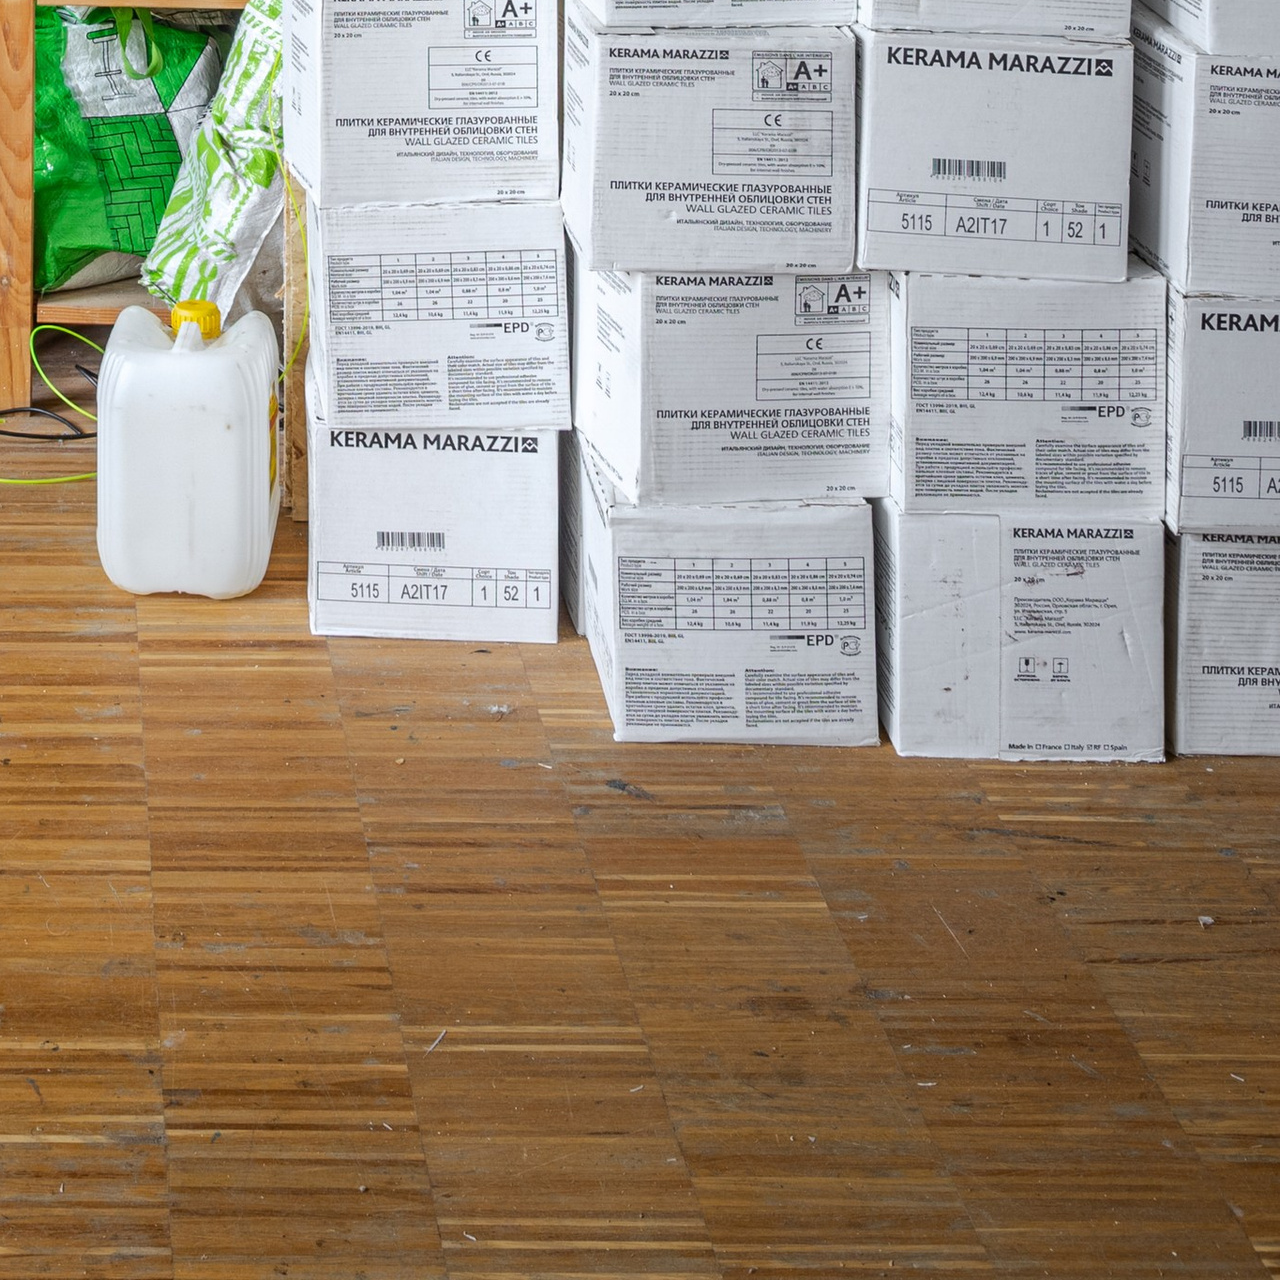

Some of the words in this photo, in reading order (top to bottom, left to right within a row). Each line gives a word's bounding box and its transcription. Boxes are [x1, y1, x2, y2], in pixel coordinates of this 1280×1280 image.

[502, 0, 533, 18] A+
[609, 48, 660, 59] KERAMA
[663, 49, 718, 60] MARAZZI
[887, 46, 982, 70] KERAMA
[988, 53, 1092, 75] MARAZZI
[794, 61, 828, 80] A+
[1210, 65, 1263, 78] KERAMA
[336, 118, 374, 126] ПЛИТКИ
[377, 117, 453, 126] КЕРАМИЧЕСКИЕ
[456, 116, 537, 125] ГЛАЗУРОВАННЫЕ
[368, 128, 386, 137] ДЛЯ
[389, 126, 450, 136] ВНУТРЕННЕЙ
[453, 126, 512, 137] ОБЛИЦОВКИ
[515, 126, 538, 134] СТЕН
[405, 137, 431, 146] WALL
[434, 137, 470, 146] GLAZED
[472, 136, 514, 145] CERAMIC
[516, 136, 538, 144] TILES
[610, 180, 653, 190] ПЛИТКИ
[655, 181, 739, 192] КЕРАМИЧЕСКИЕ
[742, 183, 832, 194] ГЛАЗУРОВАННЫЕ
[645, 192, 666, 203] ДЛЯ
[669, 192, 735, 203] ВНУТРЕННЕЙ
[738, 194, 804, 205] ОБЛИЦОВКИ
[807, 195, 832, 204] СТЕН
[686, 204, 715, 214] WALL
[717, 204, 757, 214] GLAZED
[760, 205, 806, 215] CERAMIC
[808, 206, 832, 215] TILES
[1205, 200, 1248, 210] ПЛИТКИ
[1242, 213, 1262, 223] ДЛЯ
[901, 213, 932, 231] 5115
[956, 217, 1007, 235] A2IT17
[1044, 221, 1049, 236] 1
[1067, 222, 1083, 239] 52
[1099, 223, 1106, 239] 1
[656, 276, 705, 286] KERAMA
[709, 276, 763, 286] MARAZZI
[835, 284, 866, 303] A+
[504, 322, 530, 333] EPD
[1201, 313, 1280, 332] KERAM
[656, 410, 698, 419] ПЛИТКИ
[700, 408, 781, 418] КЕРАМИЧЕСКИЕ
[784, 406, 870, 417] ГЛАЗУРОВАННЫЕ
[1098, 406, 1125, 417] EPD
[691, 419, 711, 430] ДЛЯ
[713, 417, 779, 429] ВНУТРЕННЕЙ
[781, 418, 844, 429] ОБЛИЦОВКИ
[846, 417, 870, 427] СТЕН
[730, 430, 758, 440] WALL
[761, 429, 799, 440] GLAZED
[801, 429, 845, 439] CERAMIC
[847, 428, 870, 437] TILES
[330, 431, 417, 449] KERAMA
[423, 434, 519, 453] MARAZZI
[1213, 476, 1243, 493] 5115
[1013, 528, 1064, 538] KERAMA
[1067, 528, 1122, 539] MARAZZI
[1202, 534, 1254, 544] KERAMA
[351, 583, 379, 598] 5115
[401, 584, 448, 599] A2IT17
[481, 587, 487, 600] 1
[504, 586, 519, 601] 52
[534, 587, 540, 601] 1
[807, 635, 834, 646] EPD
[1202, 666, 1245, 675] ПЛИТКИ
[1238, 677, 1258, 686] ДЛЯ
[1071, 744, 1084, 752] Italy
